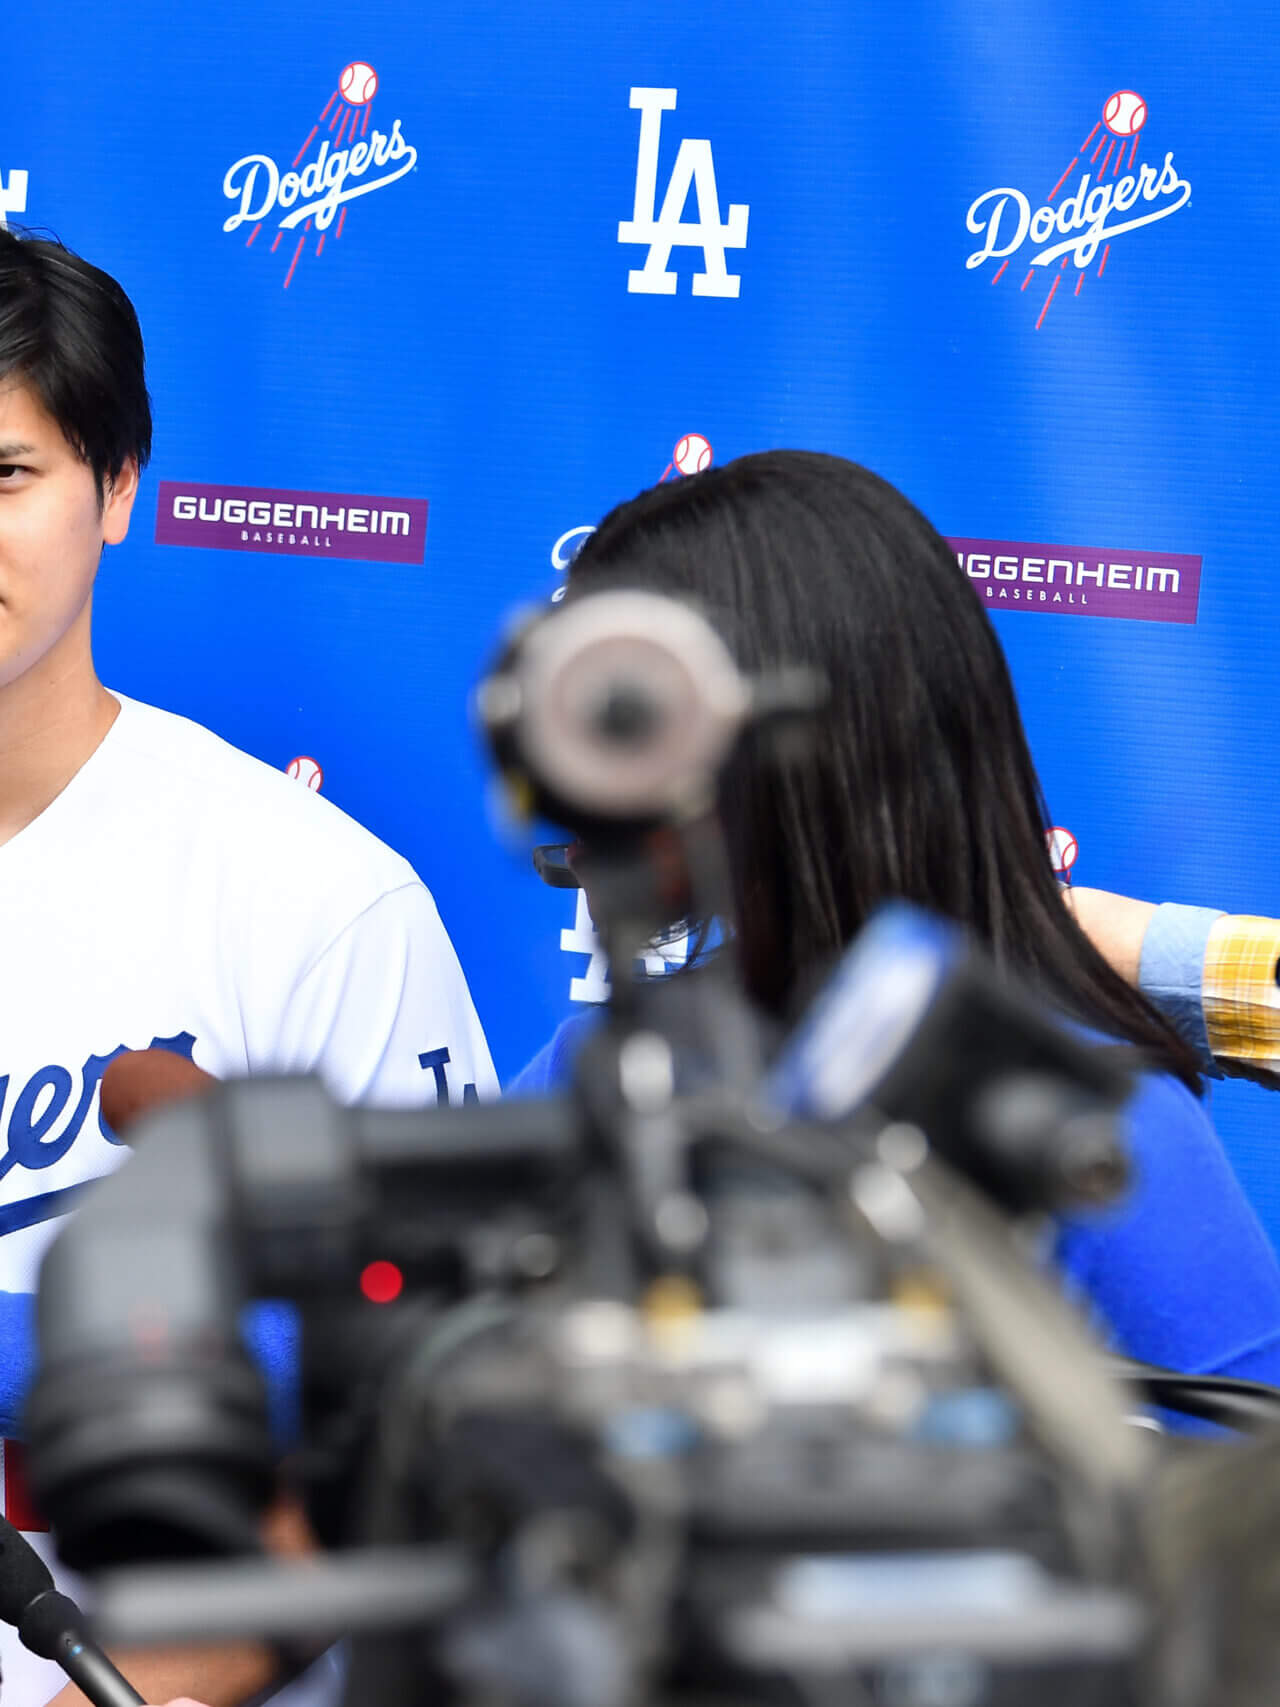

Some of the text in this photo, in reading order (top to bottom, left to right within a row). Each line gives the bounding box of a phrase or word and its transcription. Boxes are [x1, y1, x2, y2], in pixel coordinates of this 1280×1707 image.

[223, 119, 417, 232] Dodgers
[617, 87, 749, 298] LA
[966, 151, 1191, 270] Dodgers
[173, 495, 410, 536] GUGGENHEIM
[241, 530, 331, 547] BASEBALL
[957, 553, 1180, 593] GGENHEIM
[986, 586, 1088, 605] BASEBALL
